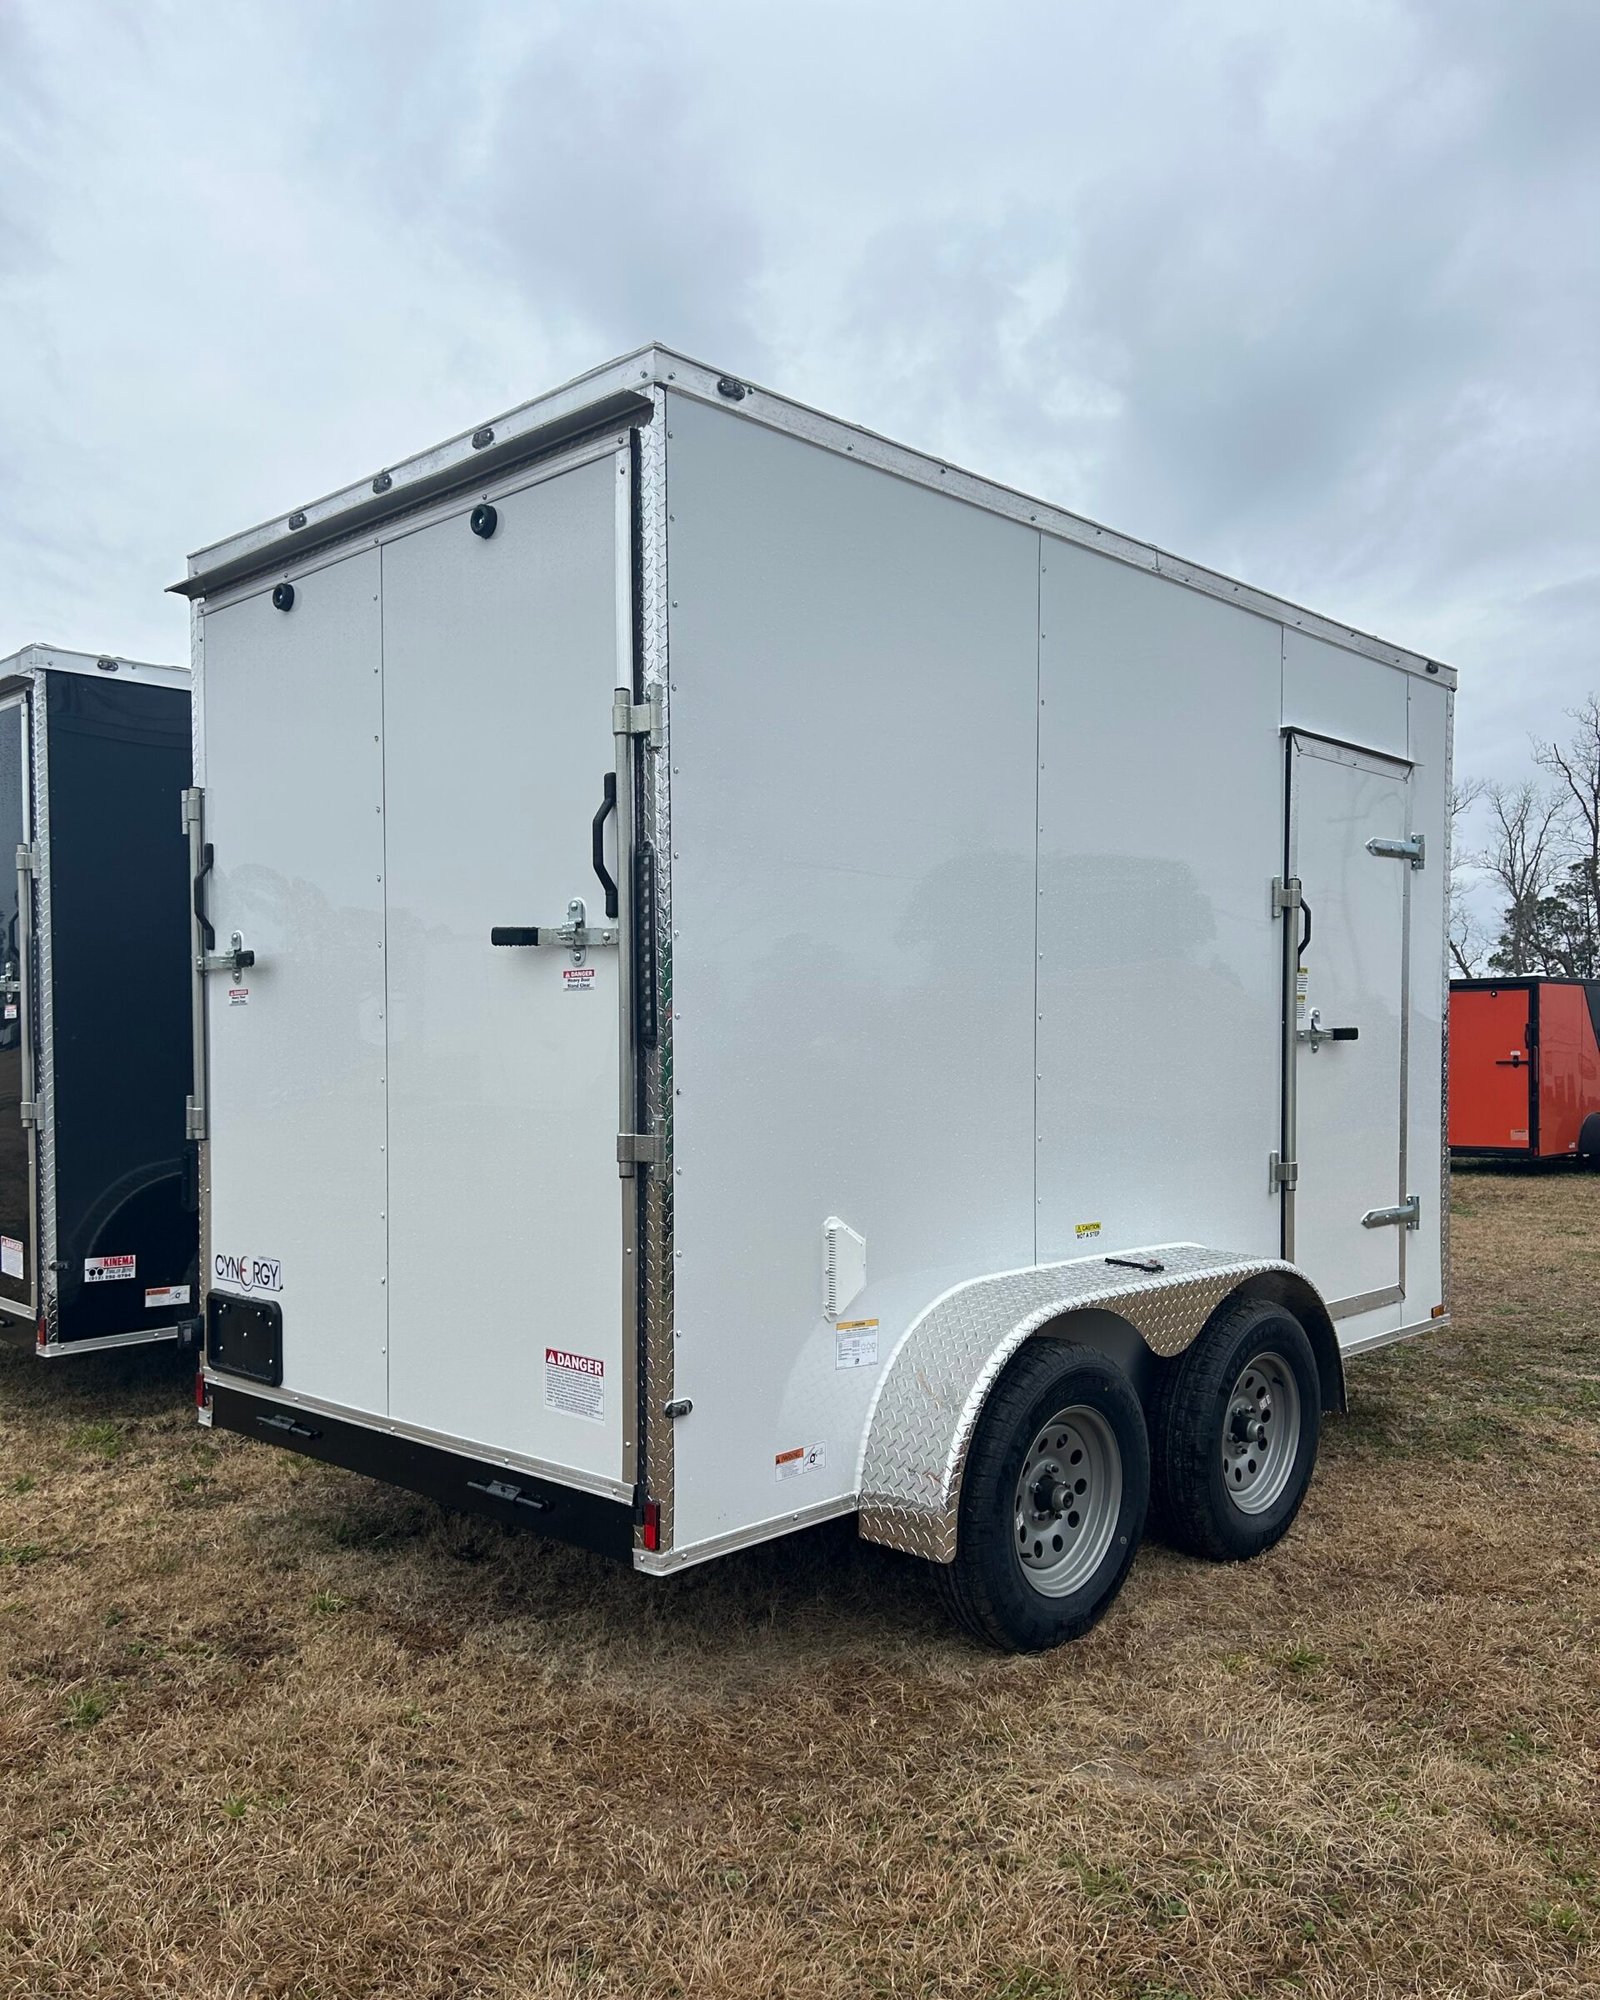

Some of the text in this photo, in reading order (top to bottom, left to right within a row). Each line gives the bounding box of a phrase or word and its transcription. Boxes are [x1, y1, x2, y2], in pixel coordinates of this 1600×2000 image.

[103, 1256, 134, 1267] KINEMA
[215, 1253, 279, 1288] CYNERGY
[556, 1352, 602, 1376] DANGER
